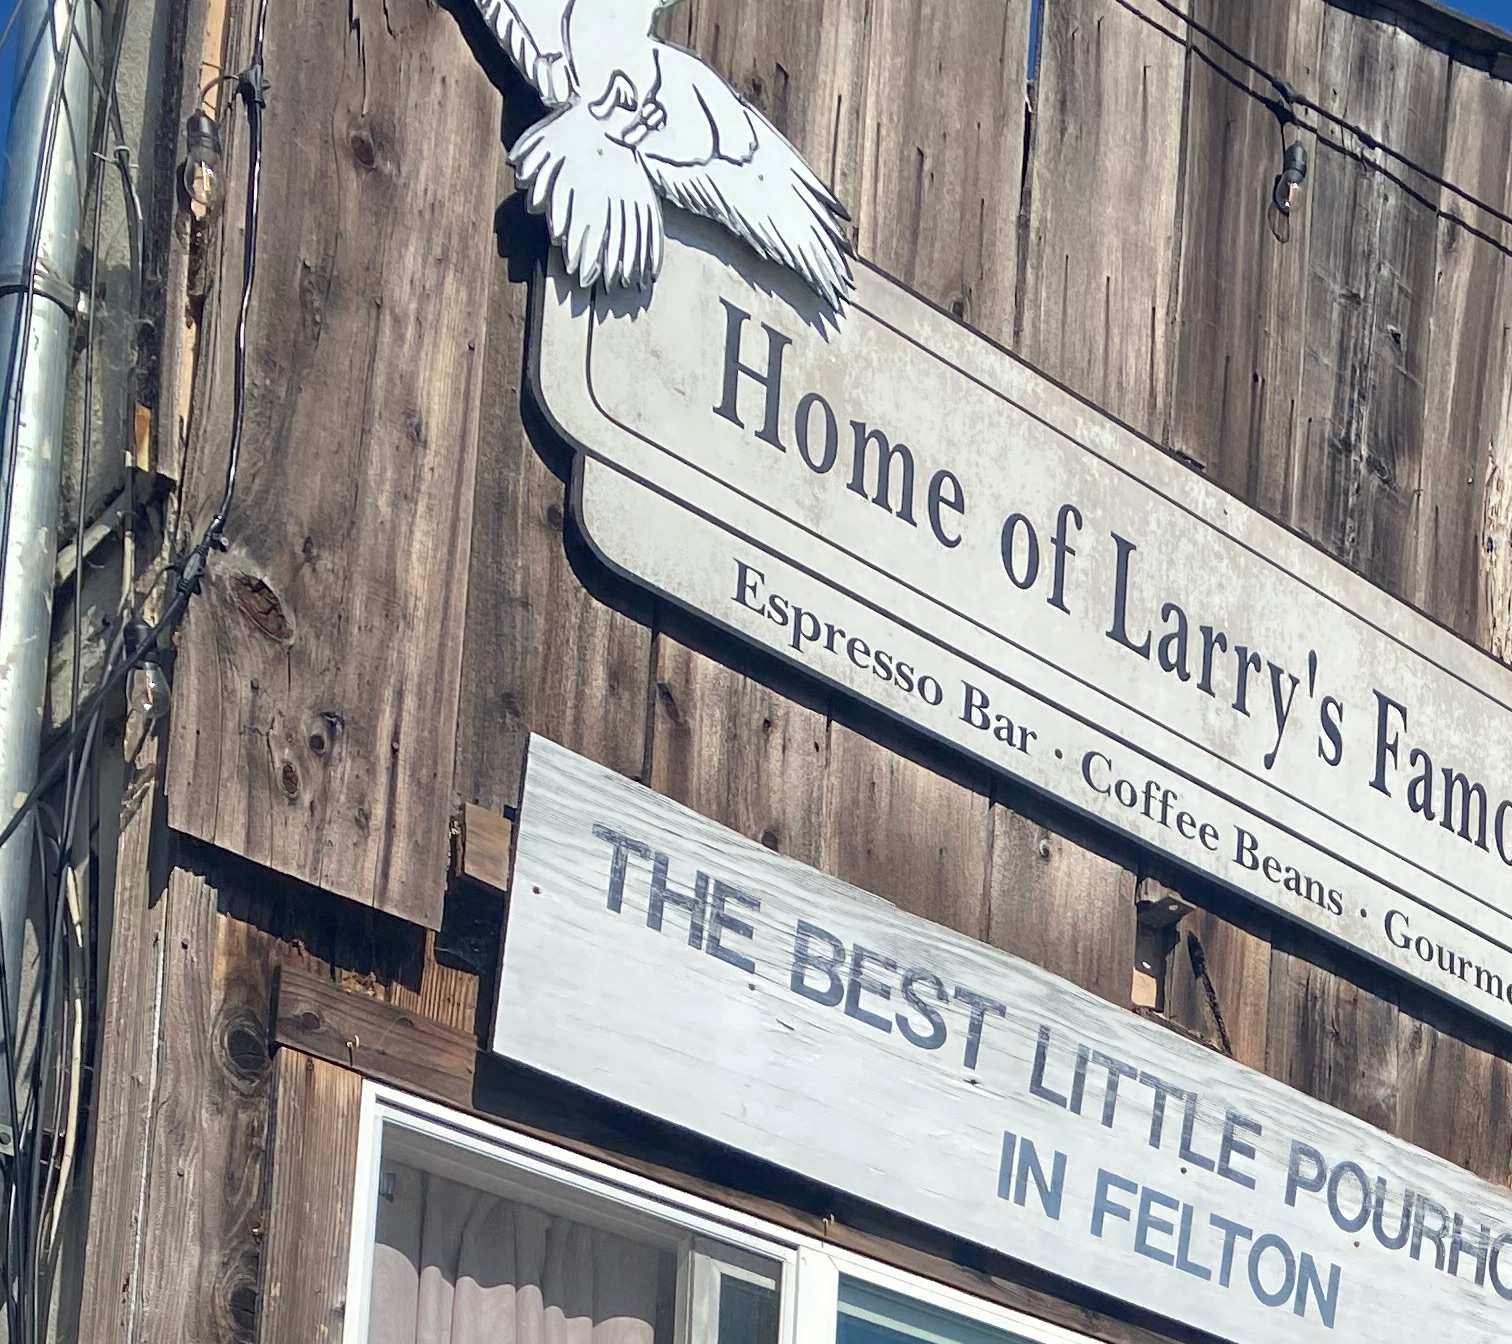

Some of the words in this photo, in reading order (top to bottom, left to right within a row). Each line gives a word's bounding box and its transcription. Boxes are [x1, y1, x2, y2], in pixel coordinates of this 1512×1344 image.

[712, 295, 965, 548] Home
[1000, 504, 1083, 615] of
[1105, 530, 1344, 770] Larry's
[732, 558, 944, 706] Espresso
[959, 680, 1038, 756] Bar
[1082, 750, 1220, 851] Coffee
[1232, 825, 1344, 917] Beans
[592, 823, 761, 974] THE
[790, 918, 1006, 1070] BEST
[1030, 1024, 1263, 1190] LITTLE
[997, 1131, 1067, 1220] IN
[1090, 1168, 1341, 1329] FELTON
